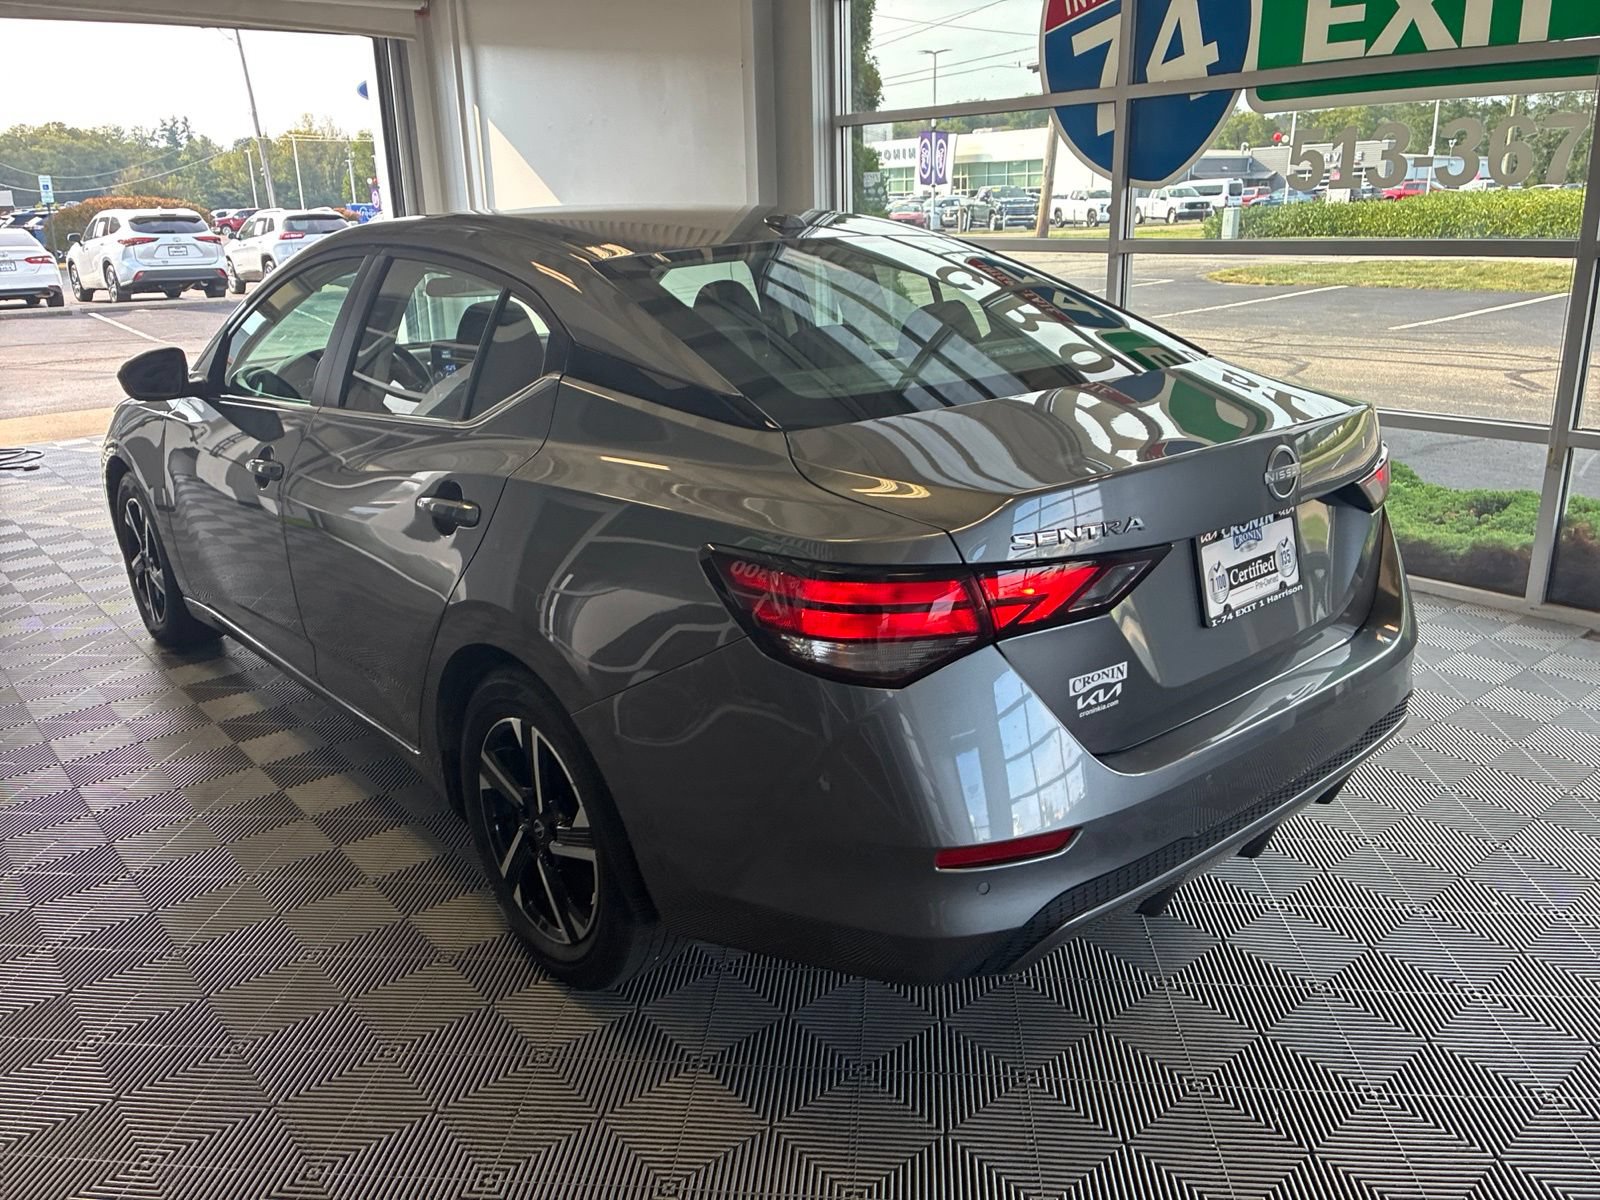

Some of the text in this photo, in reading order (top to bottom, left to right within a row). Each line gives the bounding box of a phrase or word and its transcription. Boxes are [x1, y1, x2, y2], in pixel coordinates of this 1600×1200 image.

[1071, 0, 1220, 136] 74
[878, 147, 916, 161] ONIN
[1286, 112, 1590, 190] 513-367
[1011, 516, 1145, 551] SENTRA
[1234, 528, 1262, 549] CRONIN
[1230, 555, 1275, 585] Certified
[1211, 584, 1303, 627] I-74 EXIT 1 Harrison
[1072, 663, 1126, 694] CRONIN
[1079, 699, 1119, 718] croninkia.com
